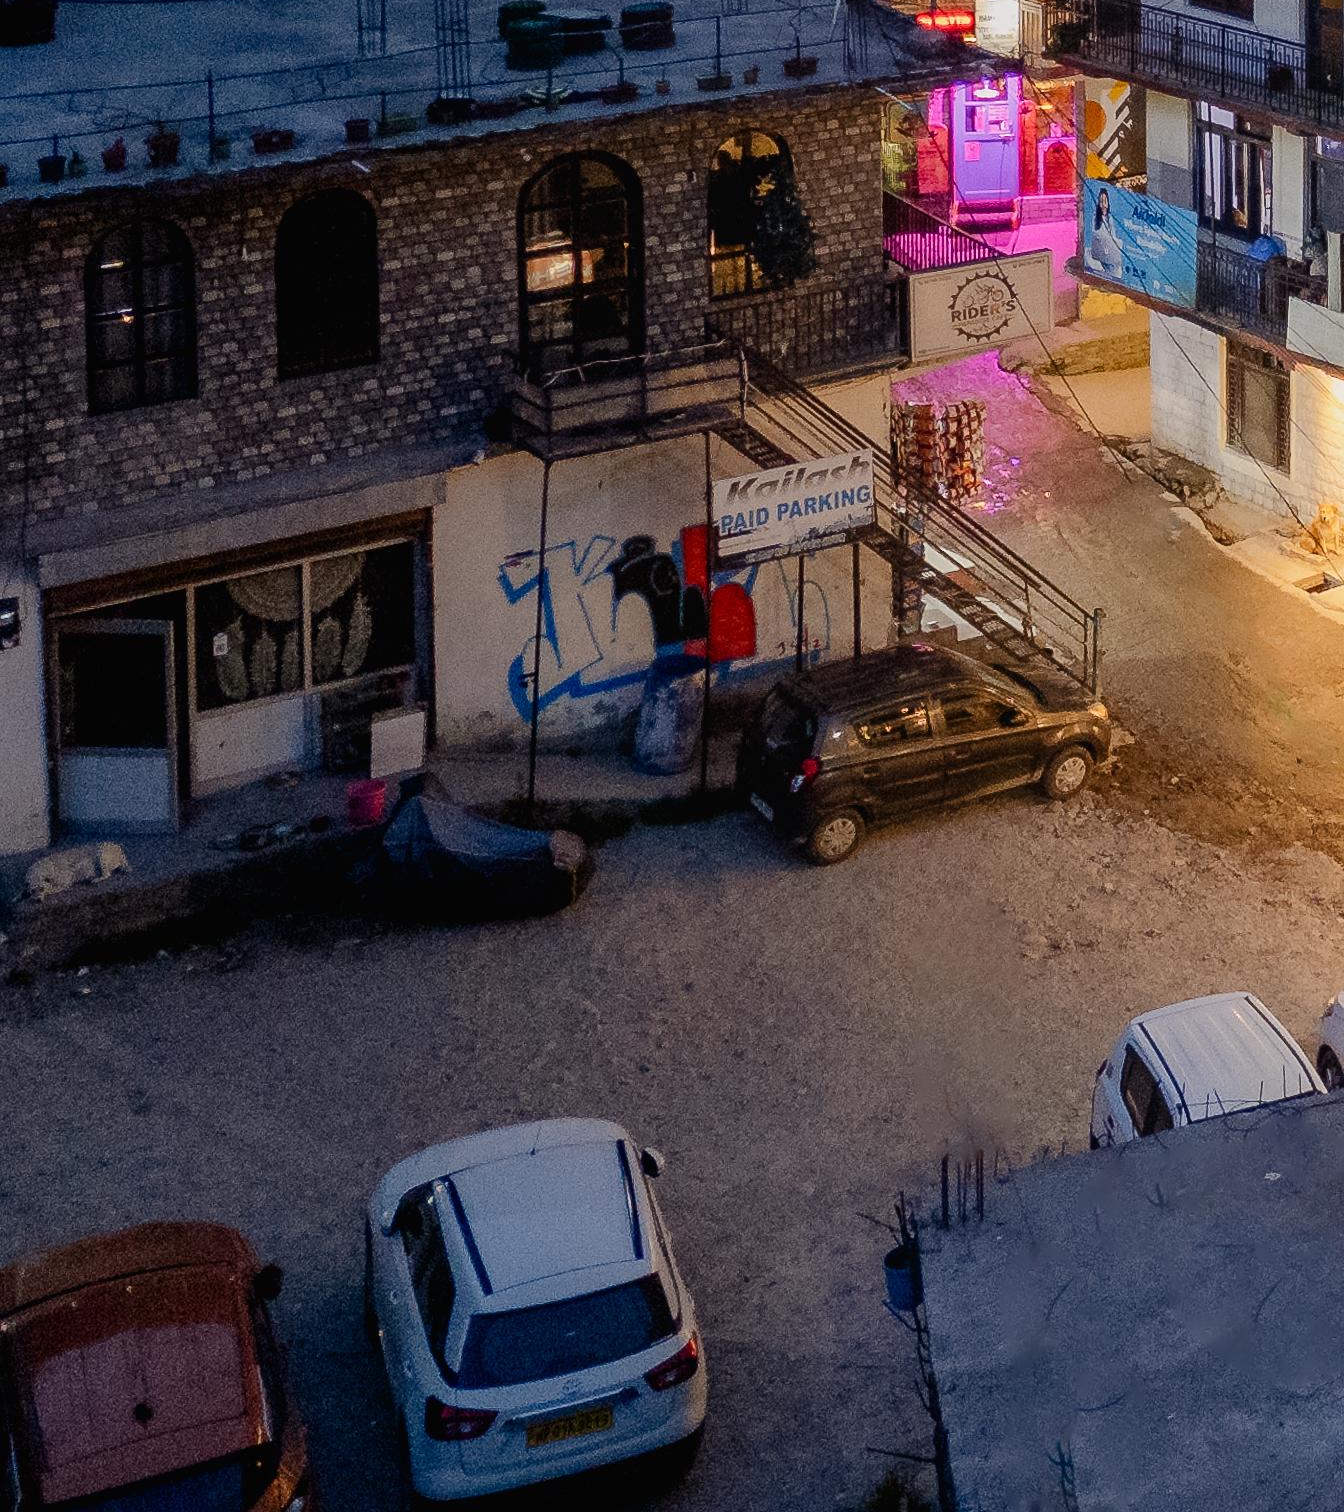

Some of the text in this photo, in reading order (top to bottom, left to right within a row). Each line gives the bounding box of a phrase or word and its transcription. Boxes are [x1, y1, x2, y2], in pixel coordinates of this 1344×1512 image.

[951, 299, 1016, 322] RIDER'S
[721, 484, 871, 534] PAID PARKING
